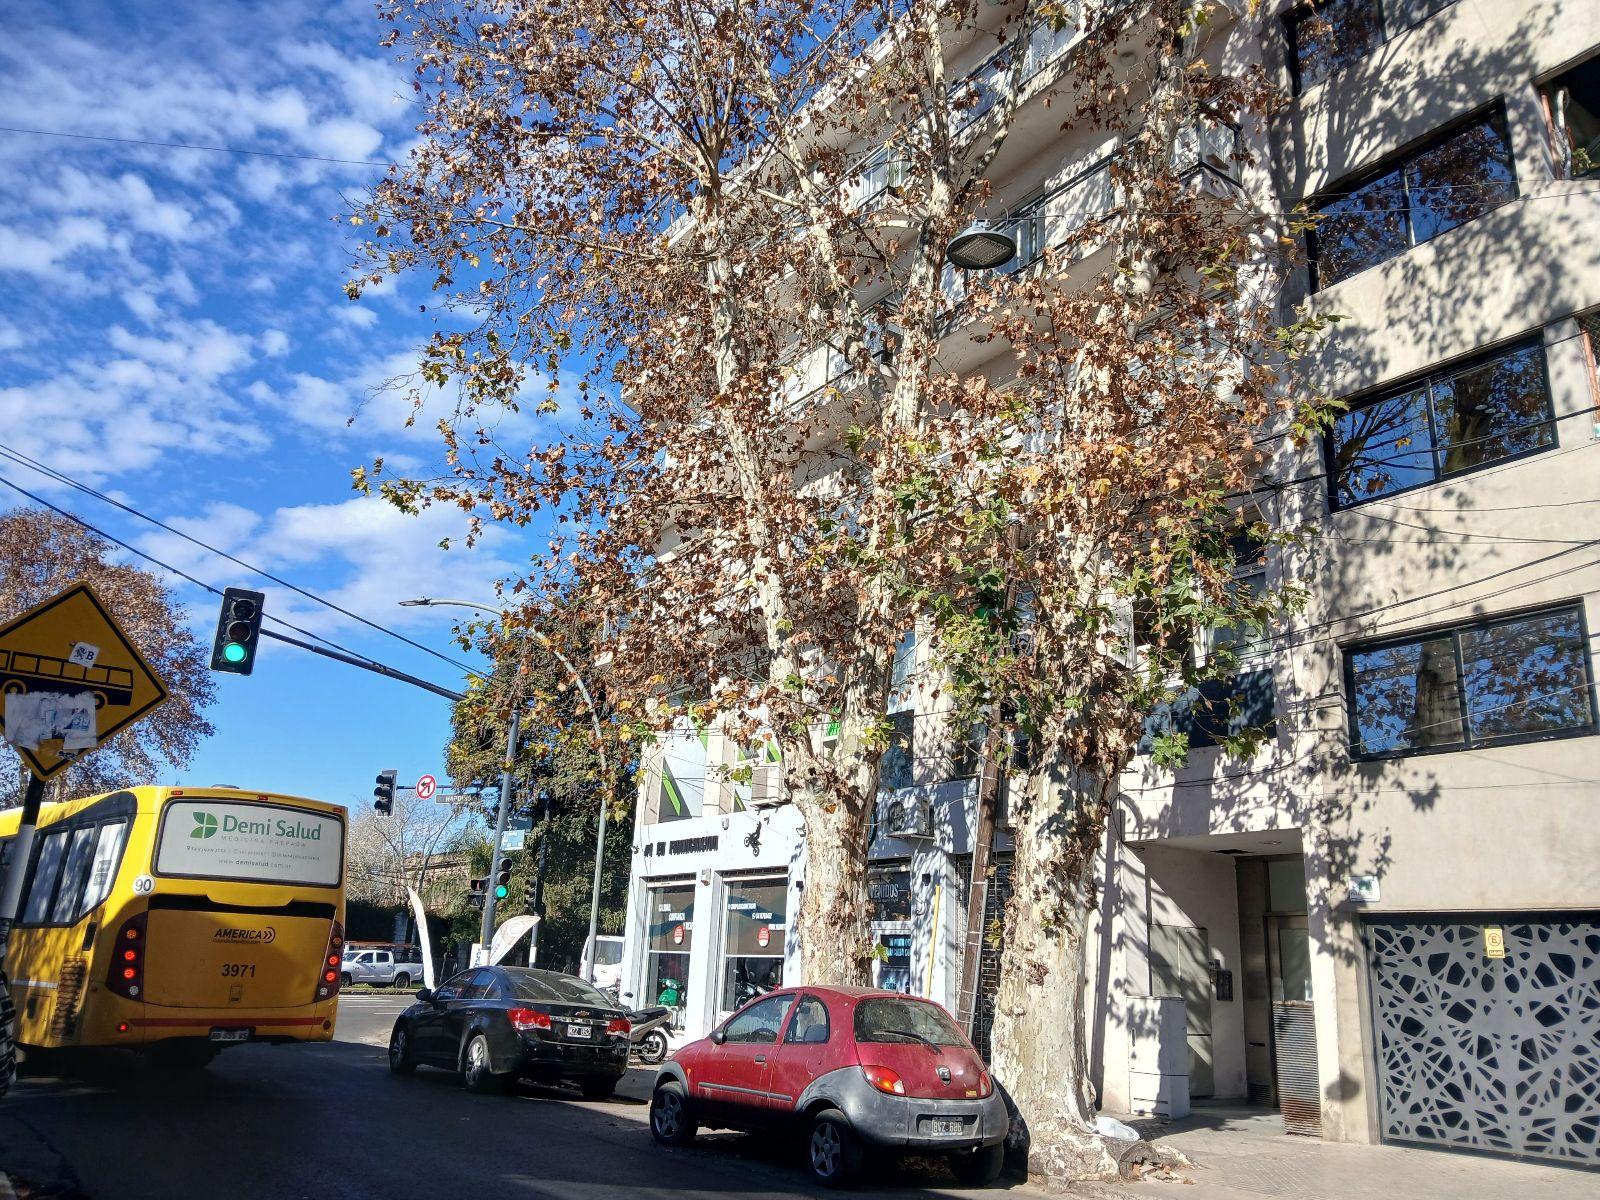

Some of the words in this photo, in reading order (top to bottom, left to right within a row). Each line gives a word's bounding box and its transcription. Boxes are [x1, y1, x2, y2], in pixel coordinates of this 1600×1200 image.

[222, 814, 272, 836] Demi
[274, 819, 322, 841] Salud
[135, 878, 152, 892] 90
[213, 928, 262, 940] AMERICA
[1491, 935, 1498, 944] E
[221, 963, 256, 978] 3971
